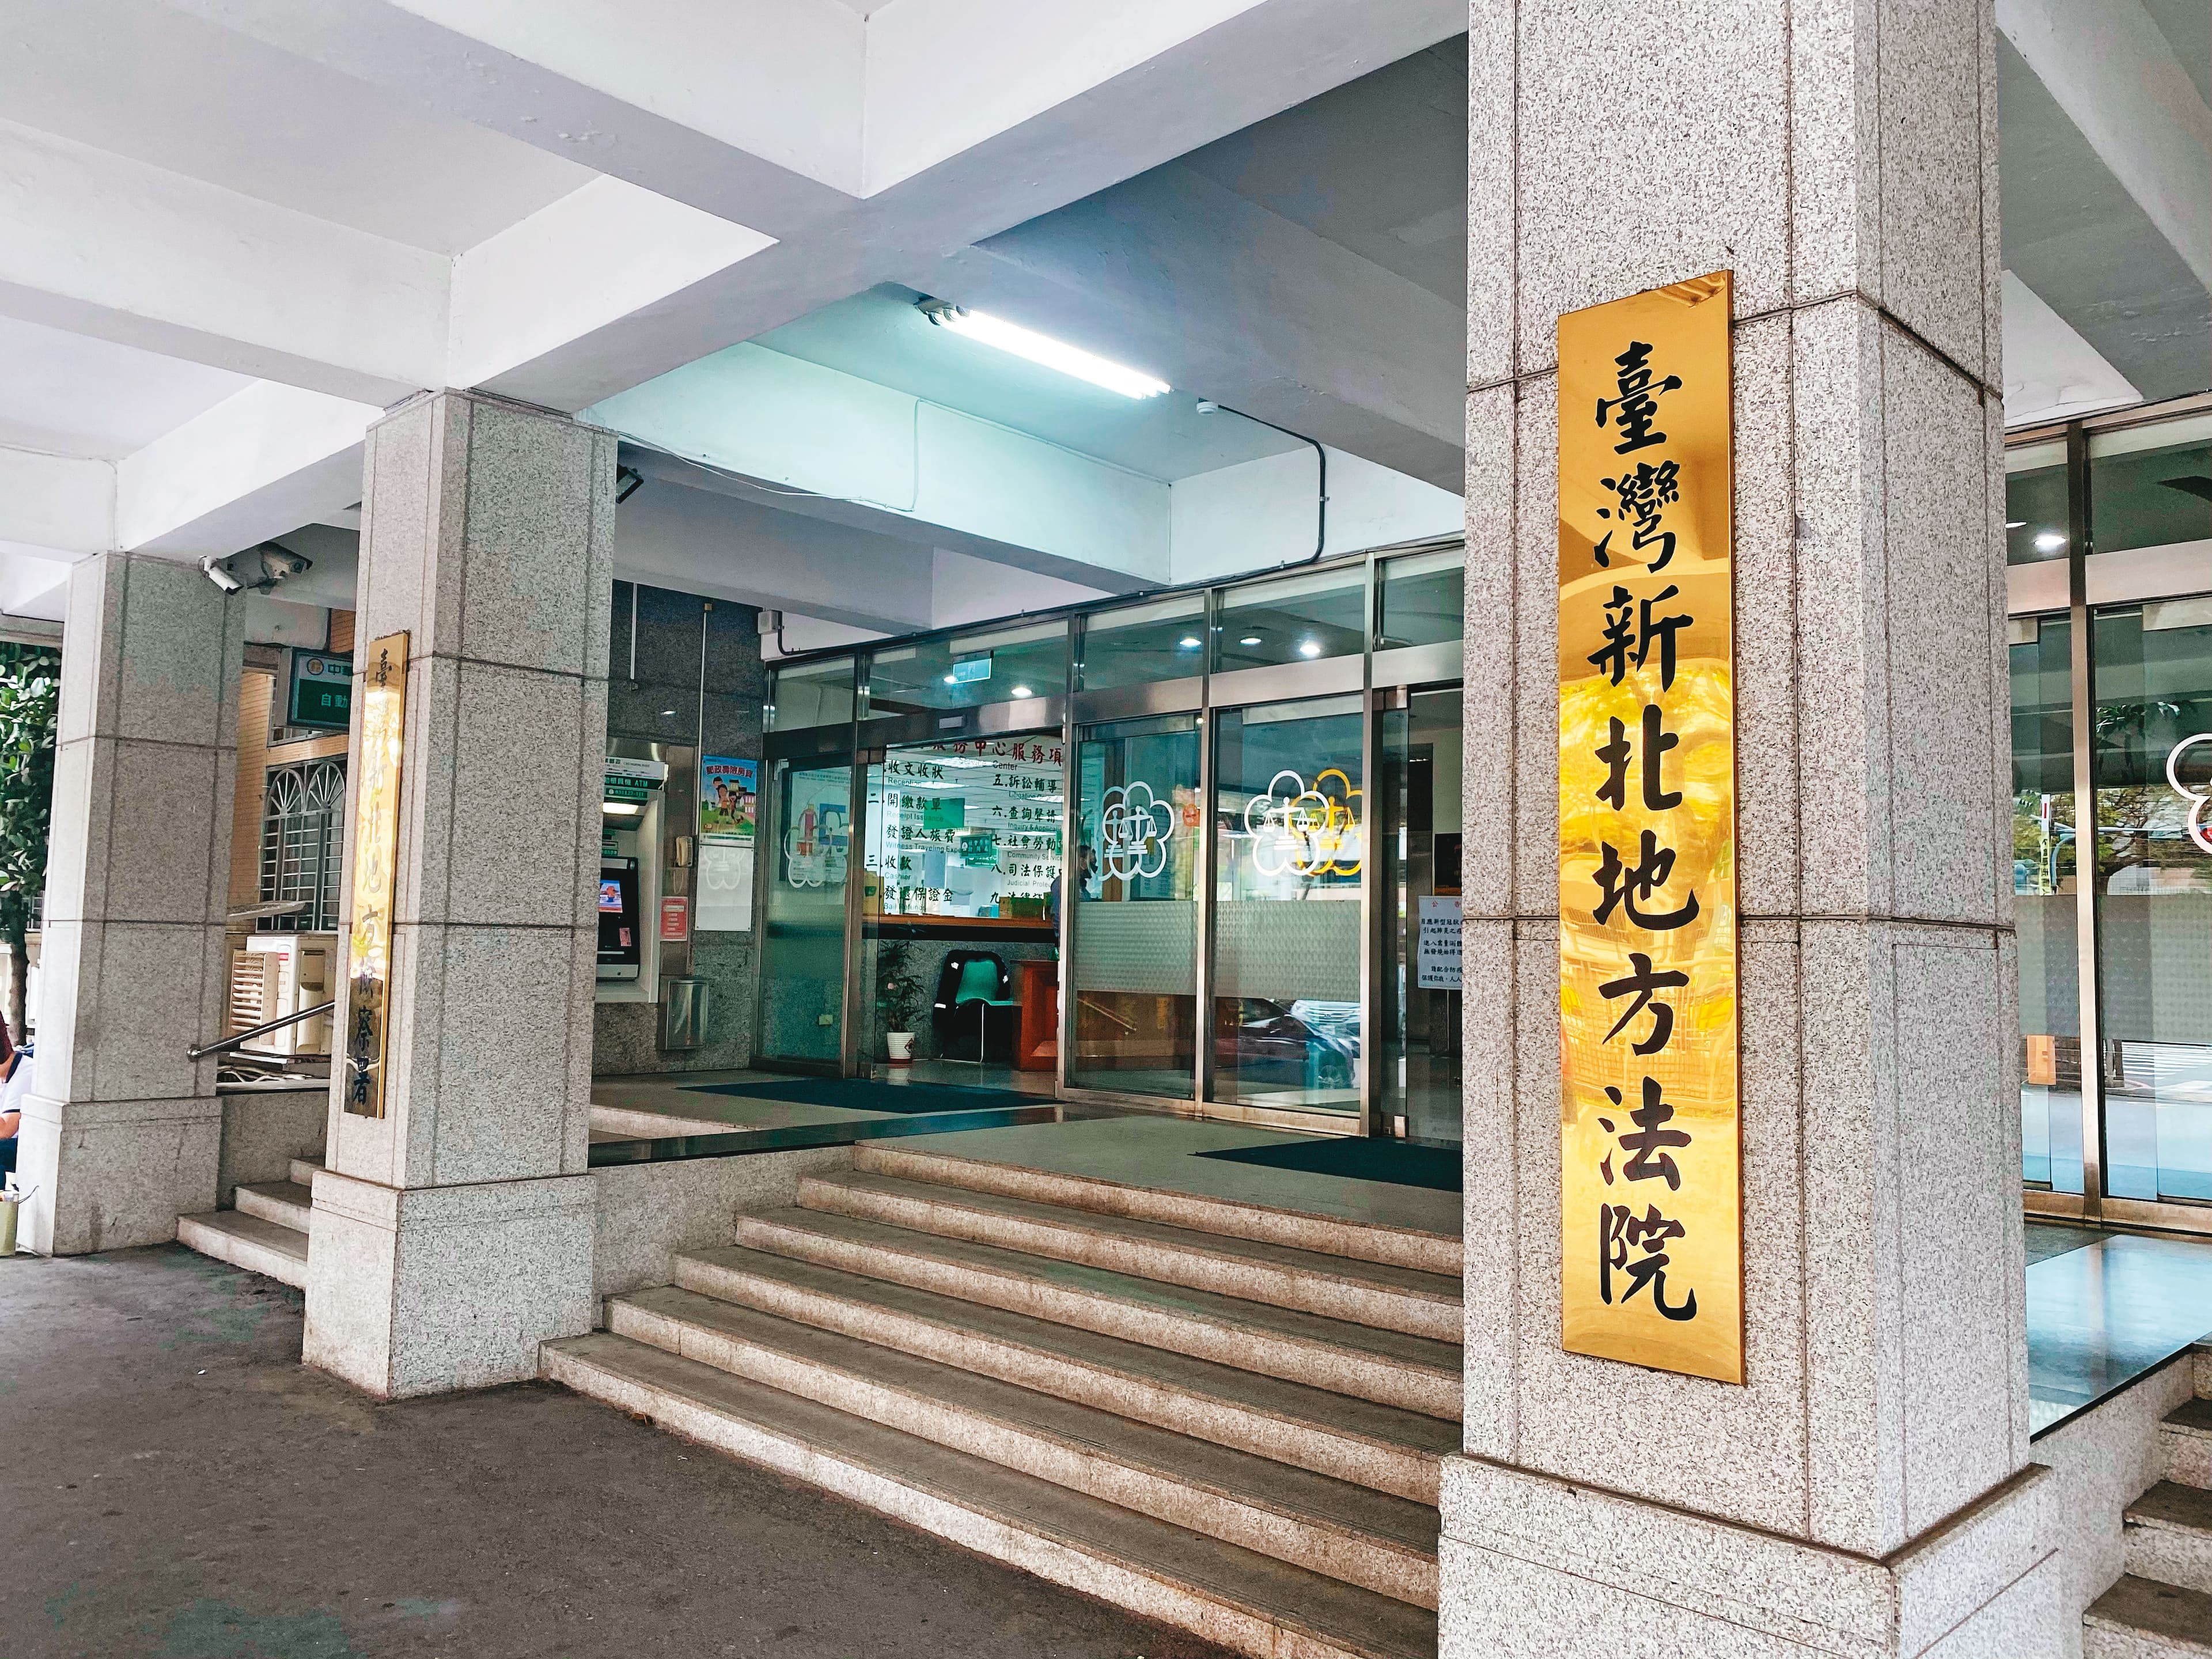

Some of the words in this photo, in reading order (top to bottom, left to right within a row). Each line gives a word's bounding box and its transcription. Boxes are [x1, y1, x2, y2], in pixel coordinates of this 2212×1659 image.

[321, 693, 348, 709] 自動
[933, 740, 1062, 767] 務中心服務項
[993, 760, 1018, 770] Center
[635, 779, 648, 787] ATM
[1008, 822, 1028, 831] Inquiry
[1587, 340, 1699, 1321] 臺灣新北地方法院
[886, 824, 956, 843] 發證人旅費
[915, 843, 944, 854] Traveling
[1007, 851, 1040, 861] Community
[353, 648, 392, 1105] 臺新北地方檢察署
[884, 872, 911, 881] Cashier
[991, 863, 1062, 880] 八.司法保護
[1007, 879, 1030, 887] Judicial
